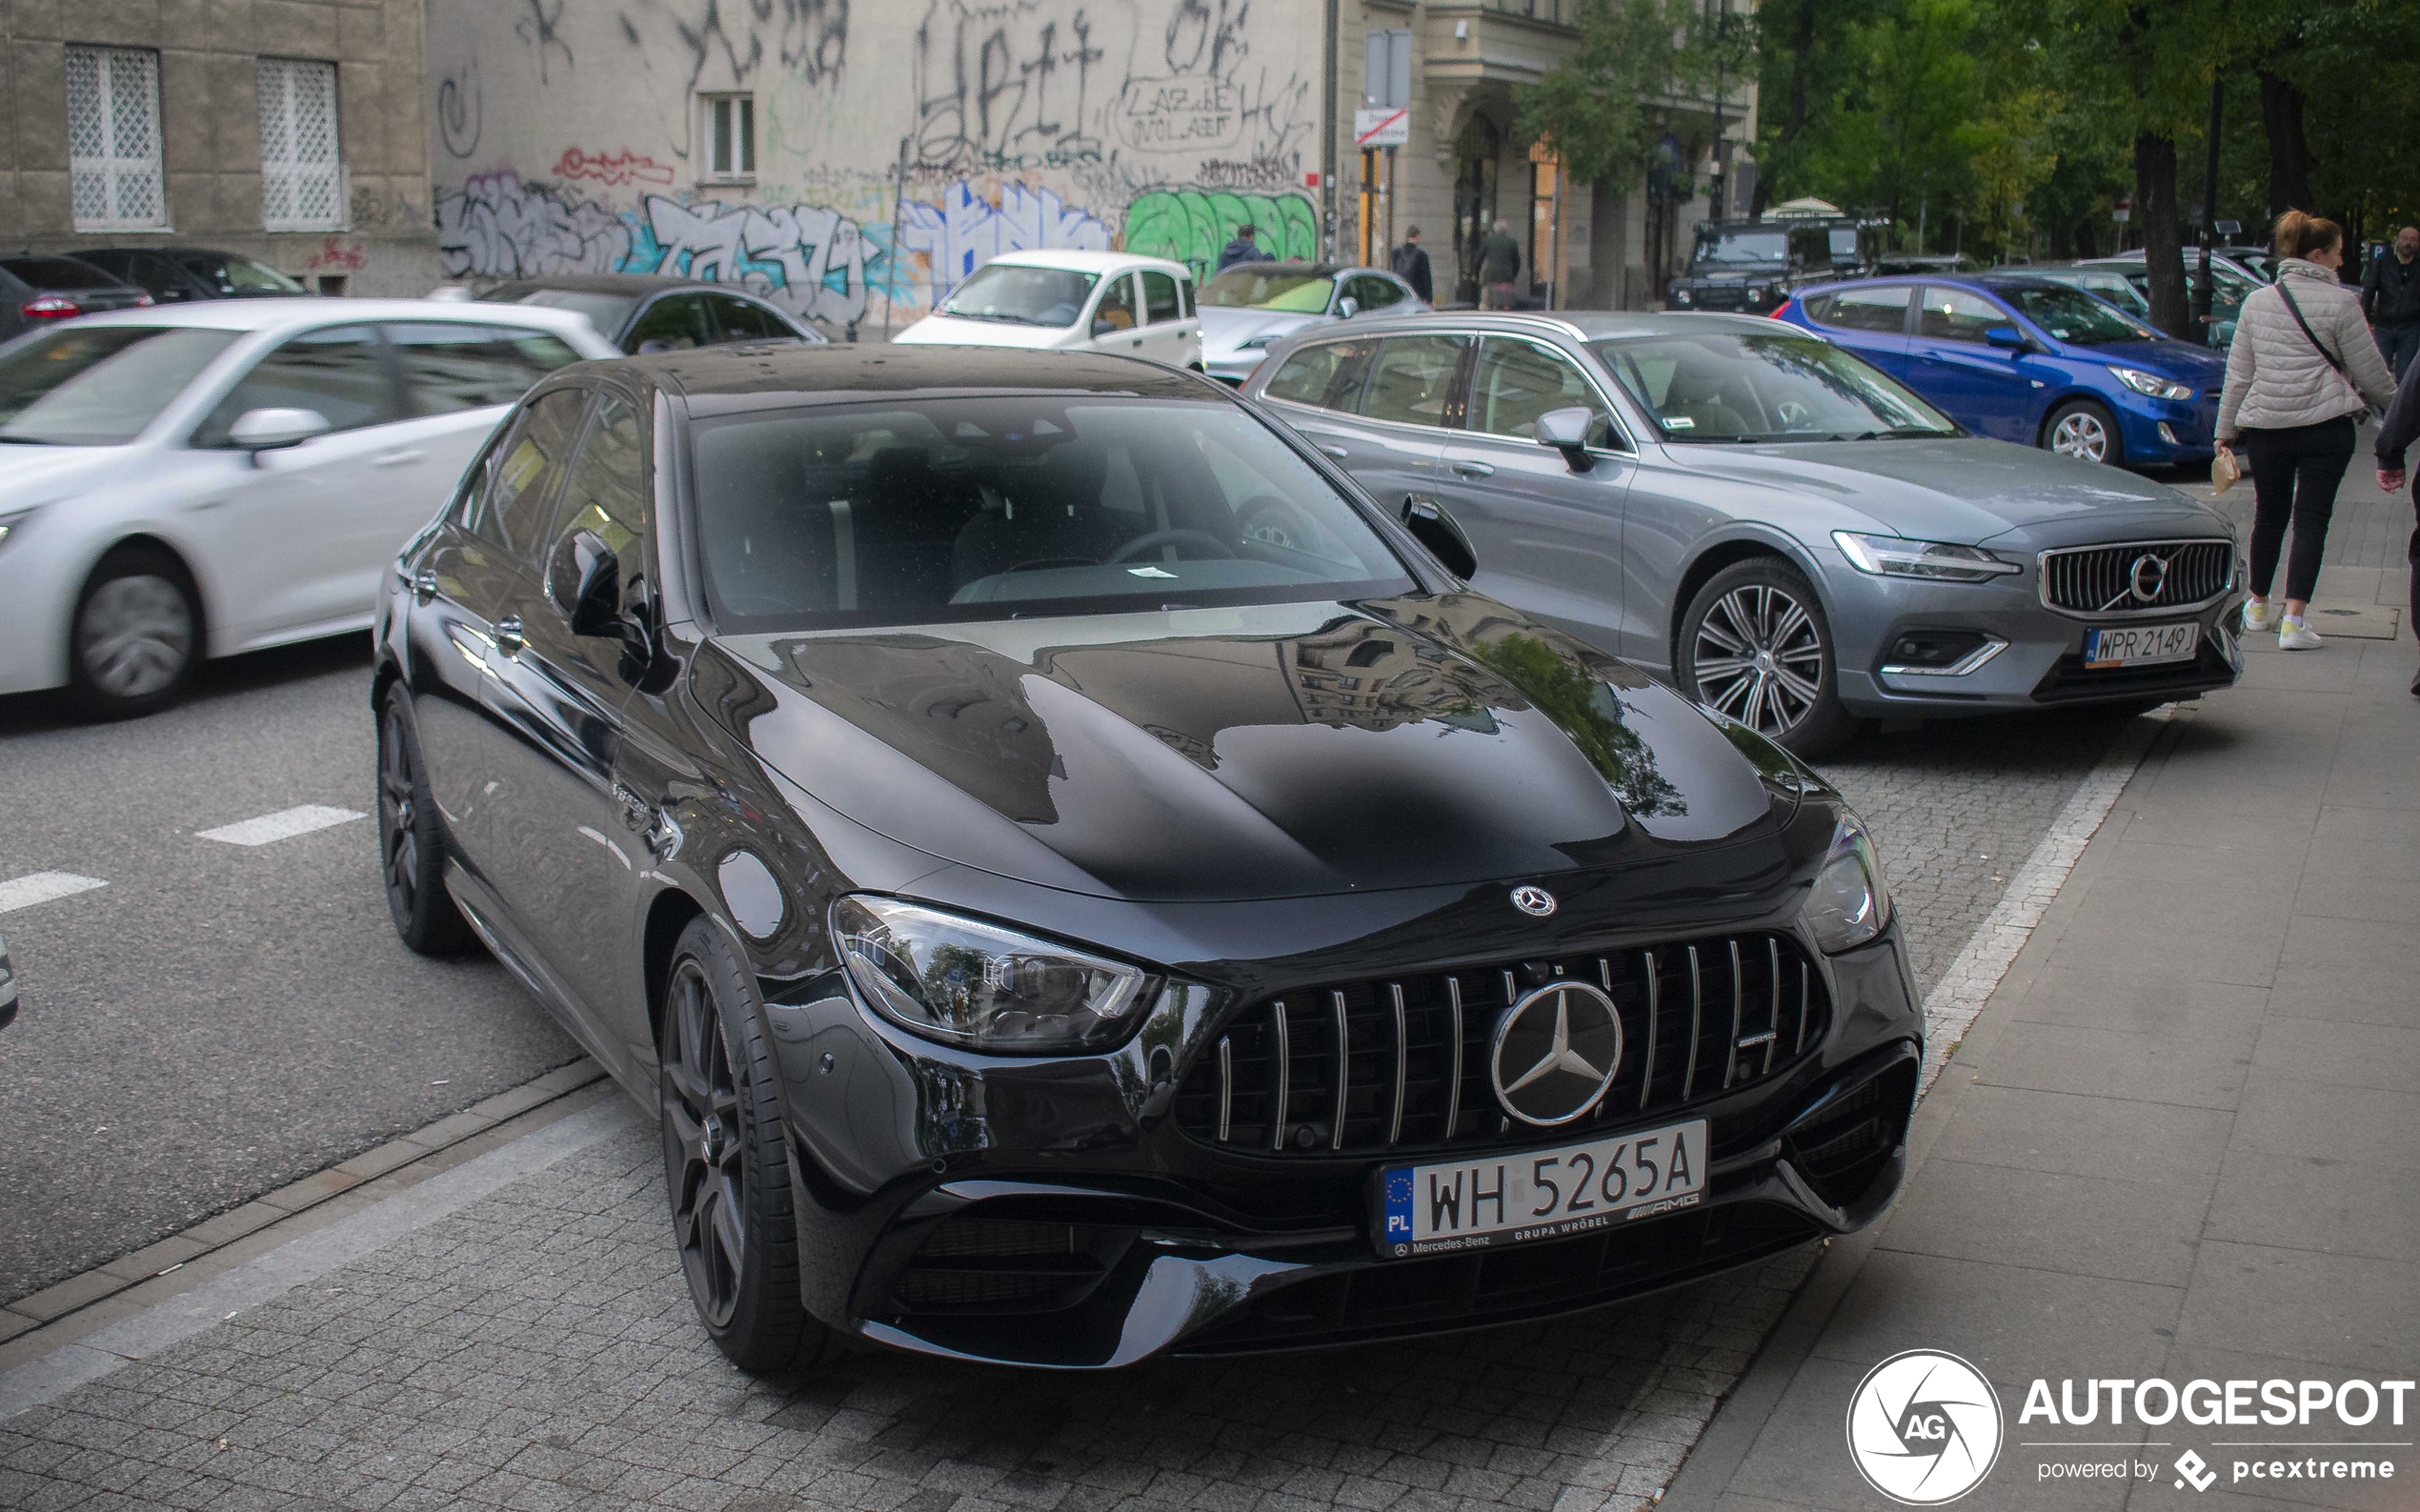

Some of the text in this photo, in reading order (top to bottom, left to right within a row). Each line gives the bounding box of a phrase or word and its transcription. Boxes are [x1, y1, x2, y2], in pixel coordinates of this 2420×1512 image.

[2374, 246, 2383, 258] P
[2098, 627, 2194, 658] WPR 2149J
[1428, 1131, 1692, 1232] WH 5265A
[1646, 1193, 1701, 1216] AMG
[1388, 1215, 1410, 1232] PL
[1514, 1216, 1609, 1240] GRUPA WRÓBEL
[1413, 1236, 1490, 1254] Mercedes-Benz
